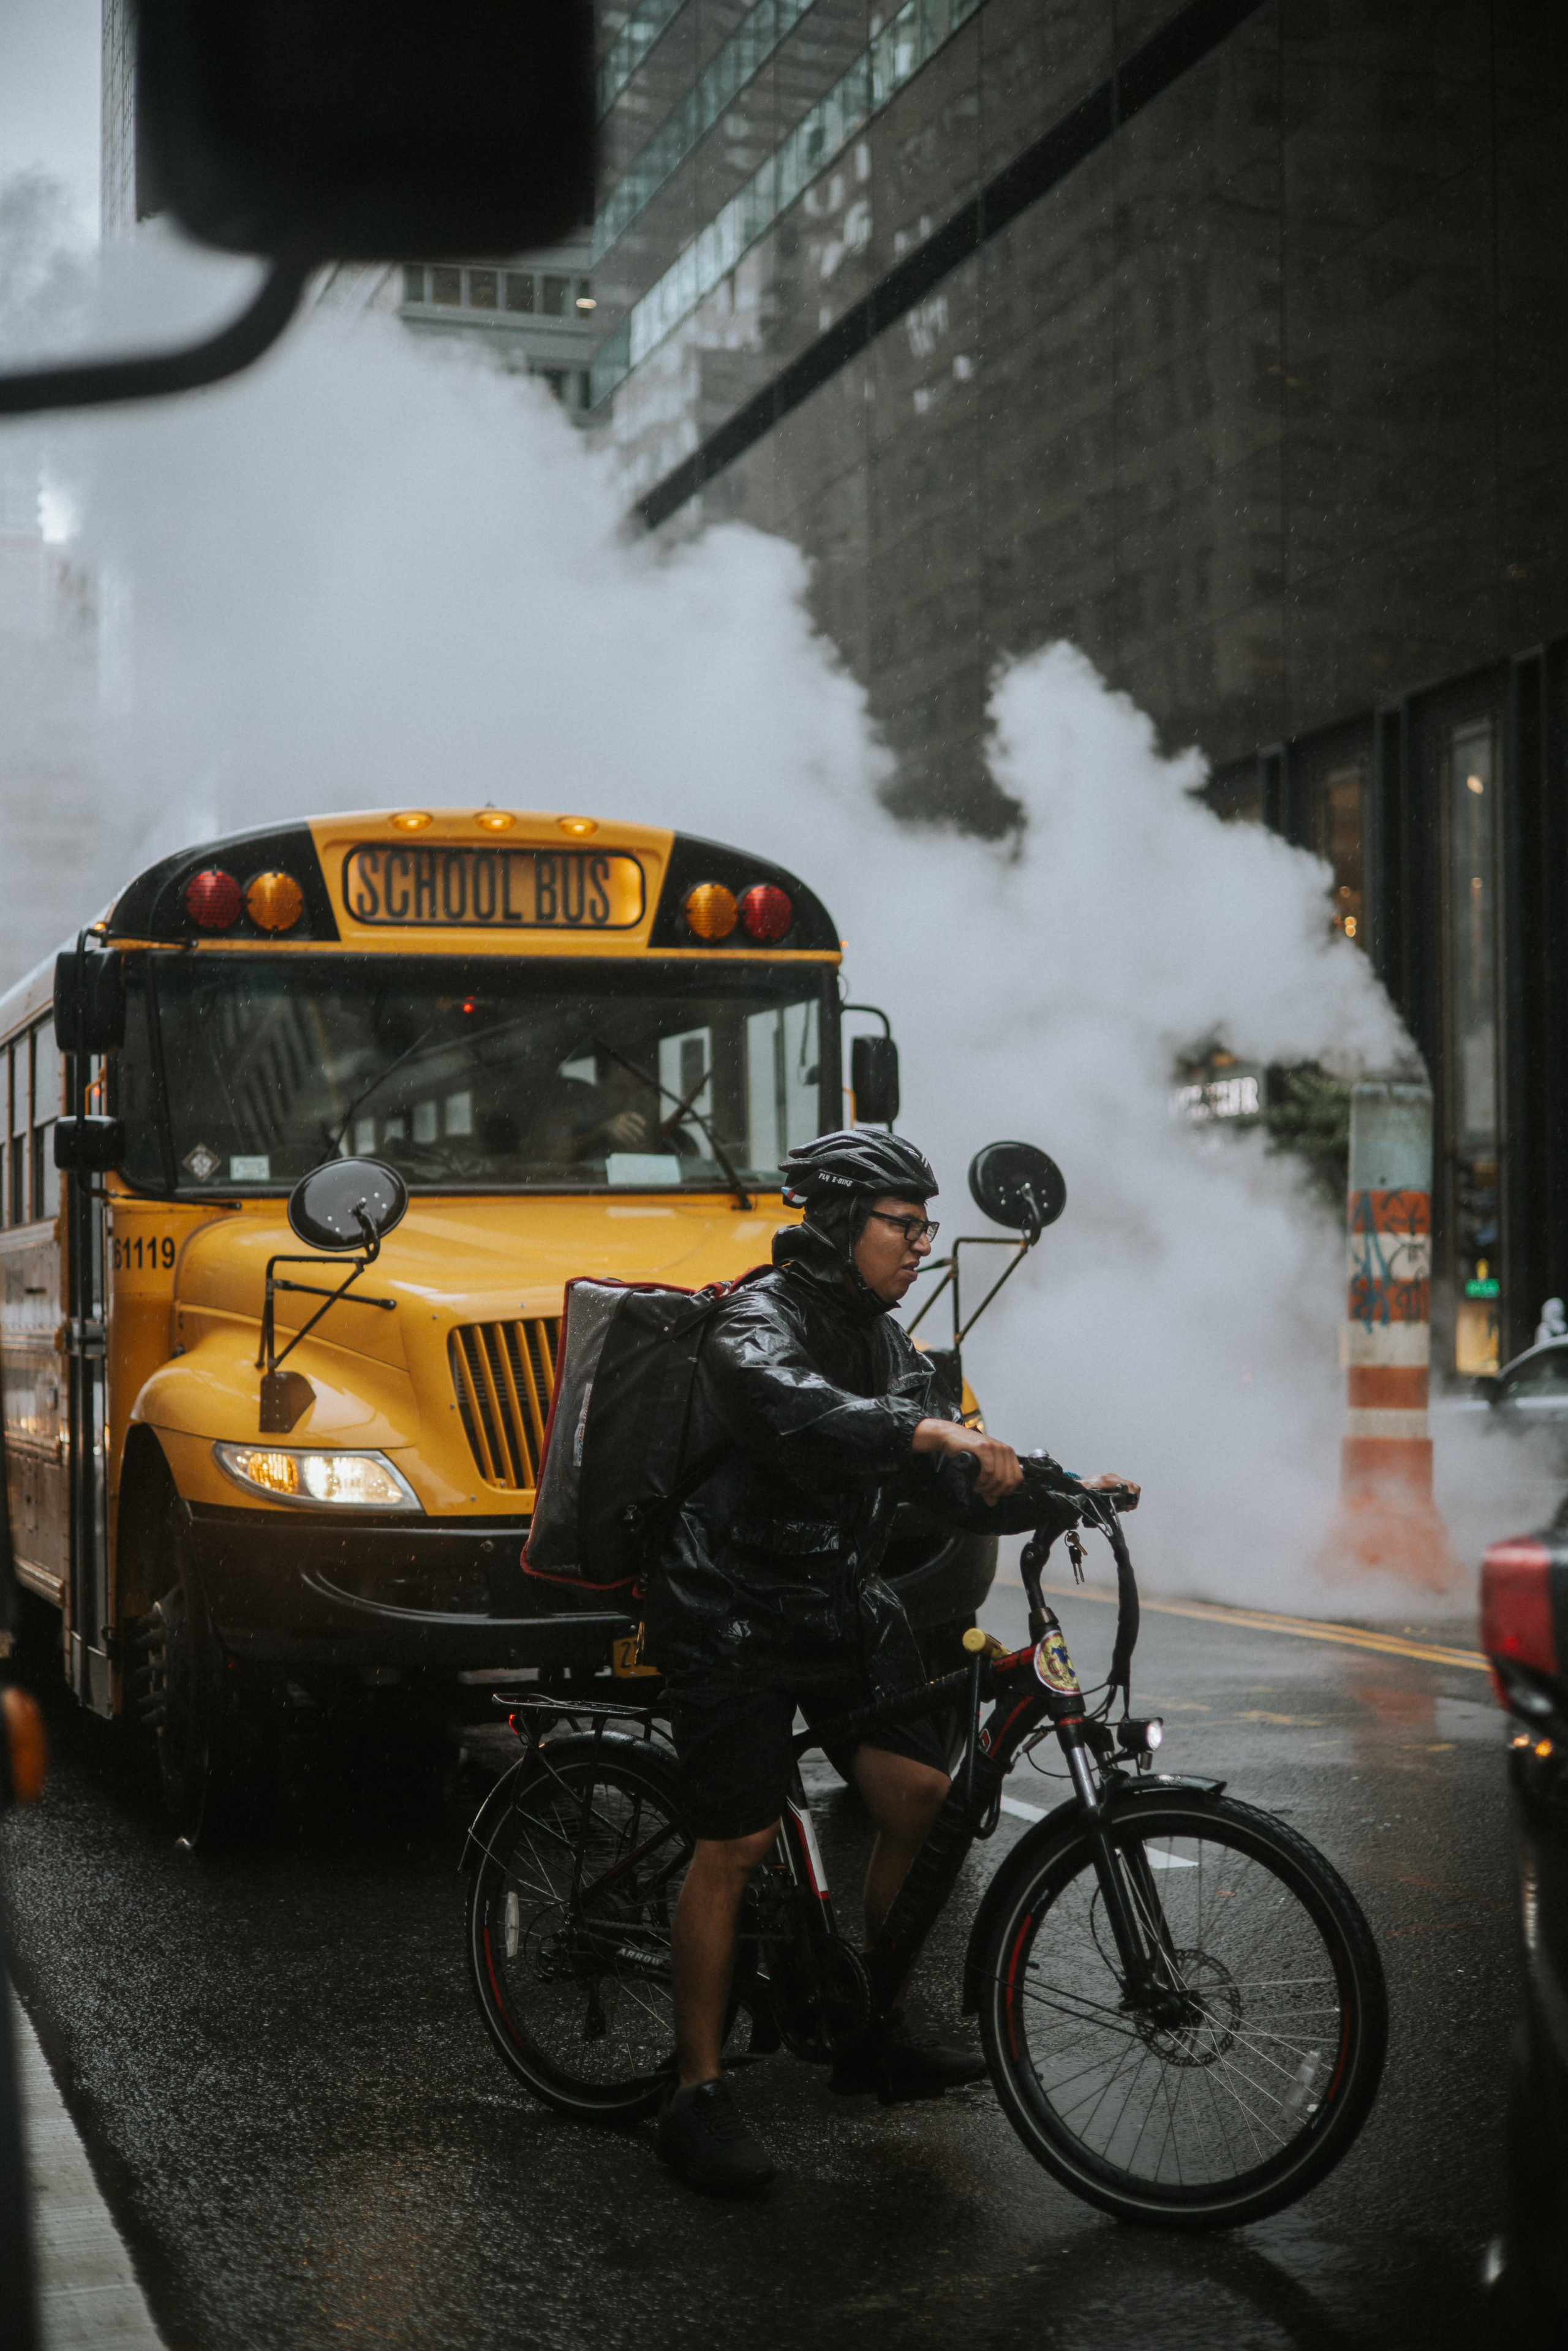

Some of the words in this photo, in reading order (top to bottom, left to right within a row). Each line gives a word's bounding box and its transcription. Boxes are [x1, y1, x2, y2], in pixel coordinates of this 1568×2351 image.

[356, 853, 522, 920] SCHOOL
[534, 855, 611, 924] BUS
[818, 1173, 830, 1182] FLY
[832, 1176, 853, 1187] E-BIKE
[114, 1236, 176, 1269] 61119
[617, 1948, 664, 1965] ARROW
